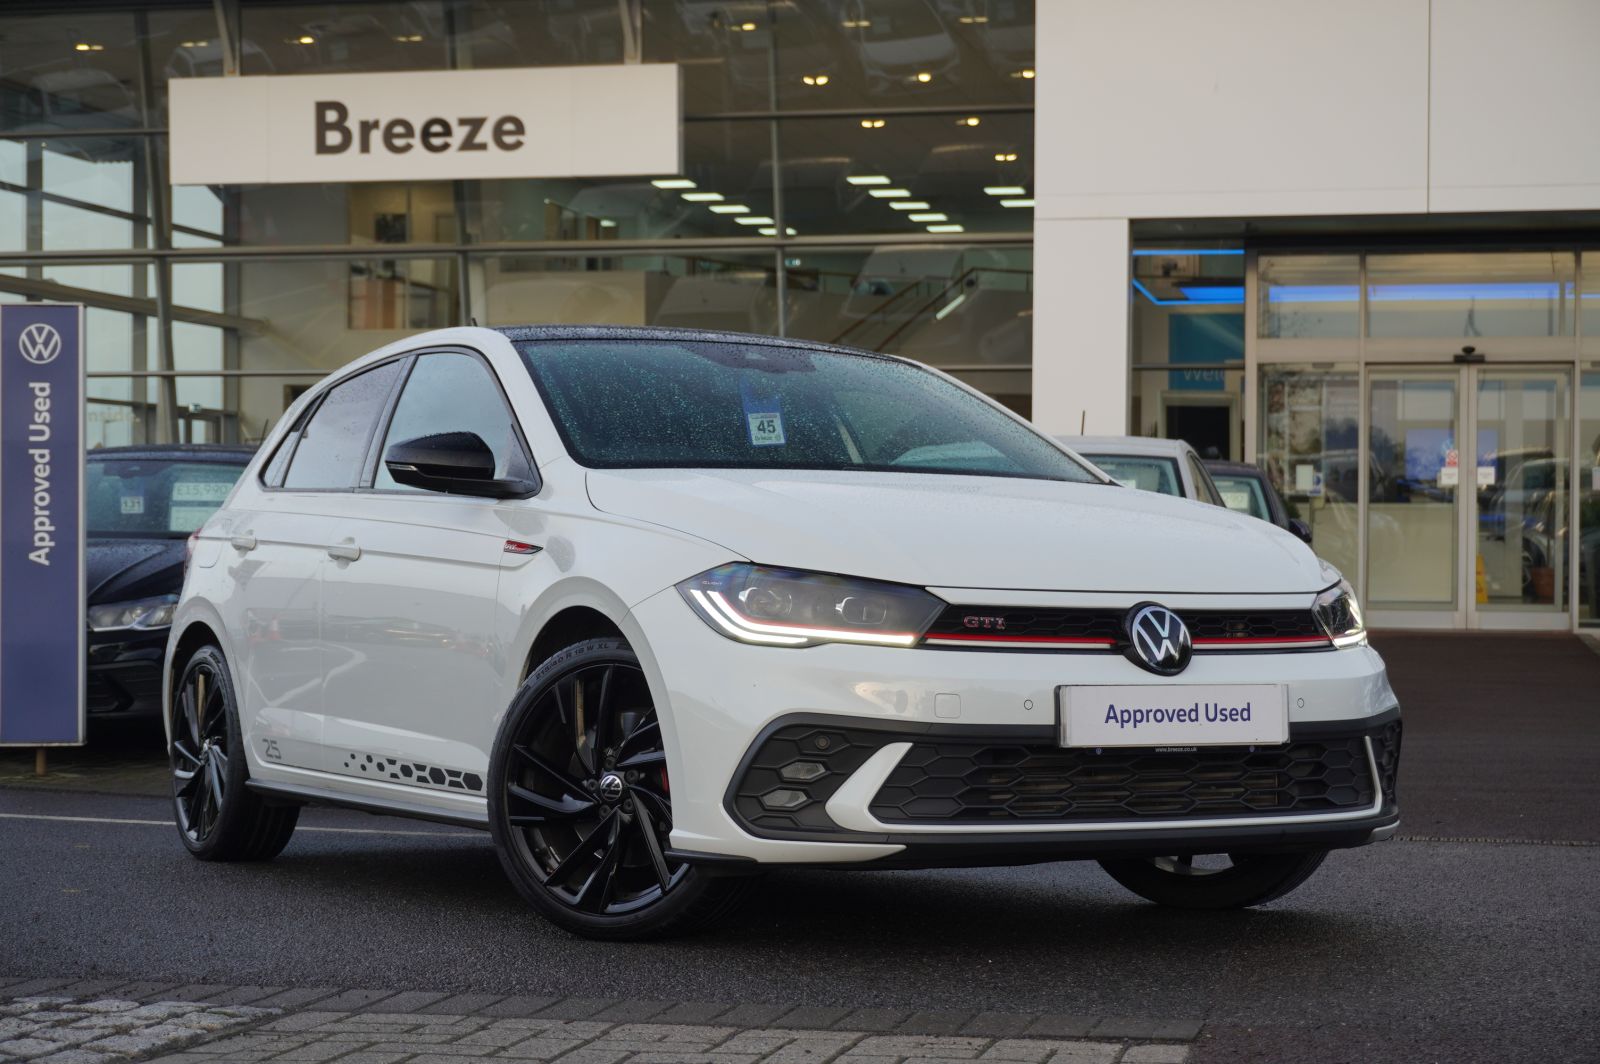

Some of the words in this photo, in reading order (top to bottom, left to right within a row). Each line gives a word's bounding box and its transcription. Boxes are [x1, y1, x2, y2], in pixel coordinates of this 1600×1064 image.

[315, 100, 526, 156] Breeze
[29, 381, 51, 442] Used
[757, 420, 776, 434] 45
[29, 448, 56, 567] Approved
[963, 615, 1006, 630] GTI
[1104, 702, 1199, 729] Approved
[1204, 702, 1251, 723] Used
[262, 738, 282, 760] 25
